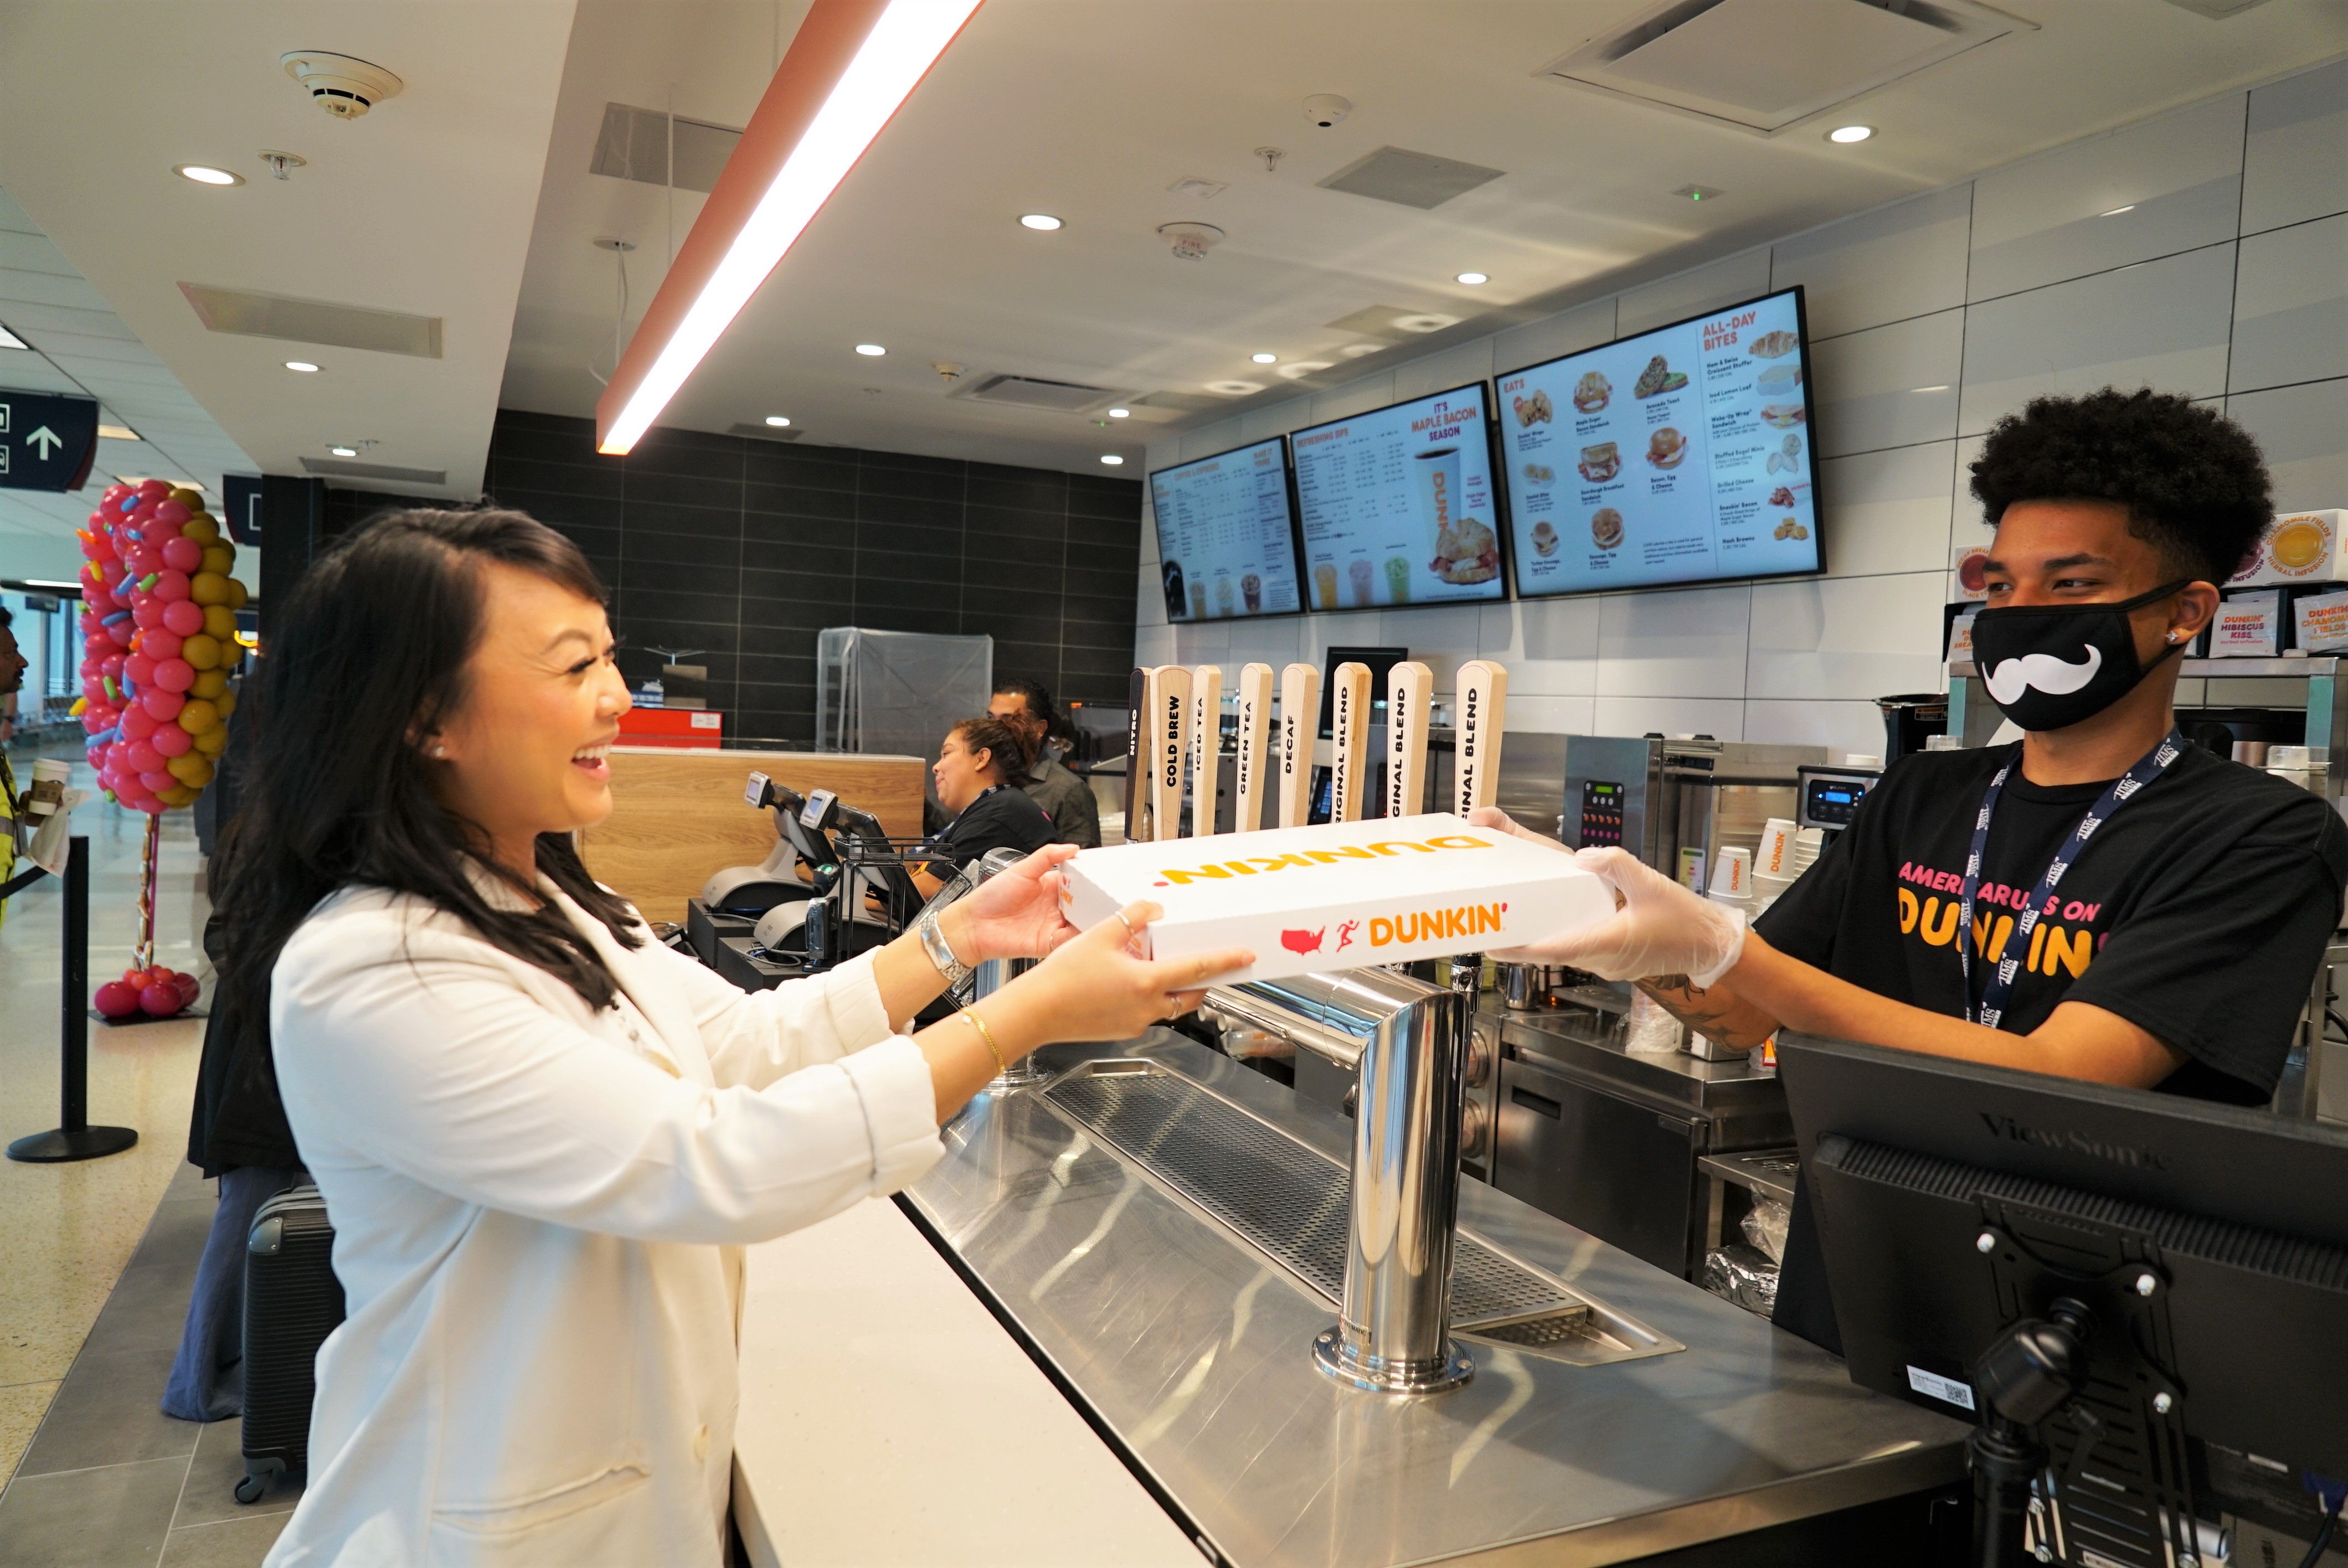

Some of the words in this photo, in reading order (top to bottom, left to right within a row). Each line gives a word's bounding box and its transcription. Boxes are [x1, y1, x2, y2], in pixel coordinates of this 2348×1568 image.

[1703, 311, 1757, 338] ALL-DAY
[1704, 331, 1738, 352] BITES
[1733, 360, 1752, 369] Stuffer
[1503, 378, 1525, 394] EATS
[1721, 388, 1738, 396] Lemon
[1412, 415, 1441, 432] MAPLE
[1443, 407, 1477, 426] BACON
[1434, 401, 1448, 414] IT'S
[1296, 432, 1335, 448] REFRESHING
[1429, 426, 1460, 442] SEASON
[2267, 515, 2311, 546] CHAMOMILE
[2311, 517, 2332, 538] FIELDS
[2267, 555, 2293, 576] HERBAL
[2294, 551, 2329, 577] INFUSION
[2224, 614, 2264, 623] DUNKIN'
[2301, 615, 2348, 627] CHAMOMI
[2308, 605, 2348, 618] DUNKIN
[2221, 622, 2265, 631] HIBISCUS
[2313, 623, 2346, 634] FIELDS
[1168, 695, 1180, 740] BREW
[1339, 687, 1347, 747] BLEND
[1396, 688, 1405, 752] BLEND
[1465, 688, 1477, 757] BLEND
[1285, 715, 1294, 774] DECAF
[1166, 744, 1177, 787] COLD
[1240, 740, 1249, 795] GREEN
[1336, 753, 1345, 823] RIGINAL
[1392, 759, 1402, 817] GINAL
[1461, 764, 1473, 819] INAL
[2113, 778, 2136, 801] HMS
[2076, 817, 2097, 842] HMS
[1153, 835, 1495, 887] DUNKIN'
[1770, 831, 1785, 873] DUNKIN'
[1731, 859, 1741, 891] DUNKIN'
[2046, 861, 2063, 889] HMS
[1898, 862, 1994, 903] AMERIA
[1993, 884, 2061, 916] RUS
[2063, 901, 2102, 922] ON
[1368, 902, 1507, 947] DUNKIN'
[2019, 909, 2035, 937] HMS
[1998, 958, 2014, 987] HMS
[1979, 1111, 2172, 1172] ViewSonic
